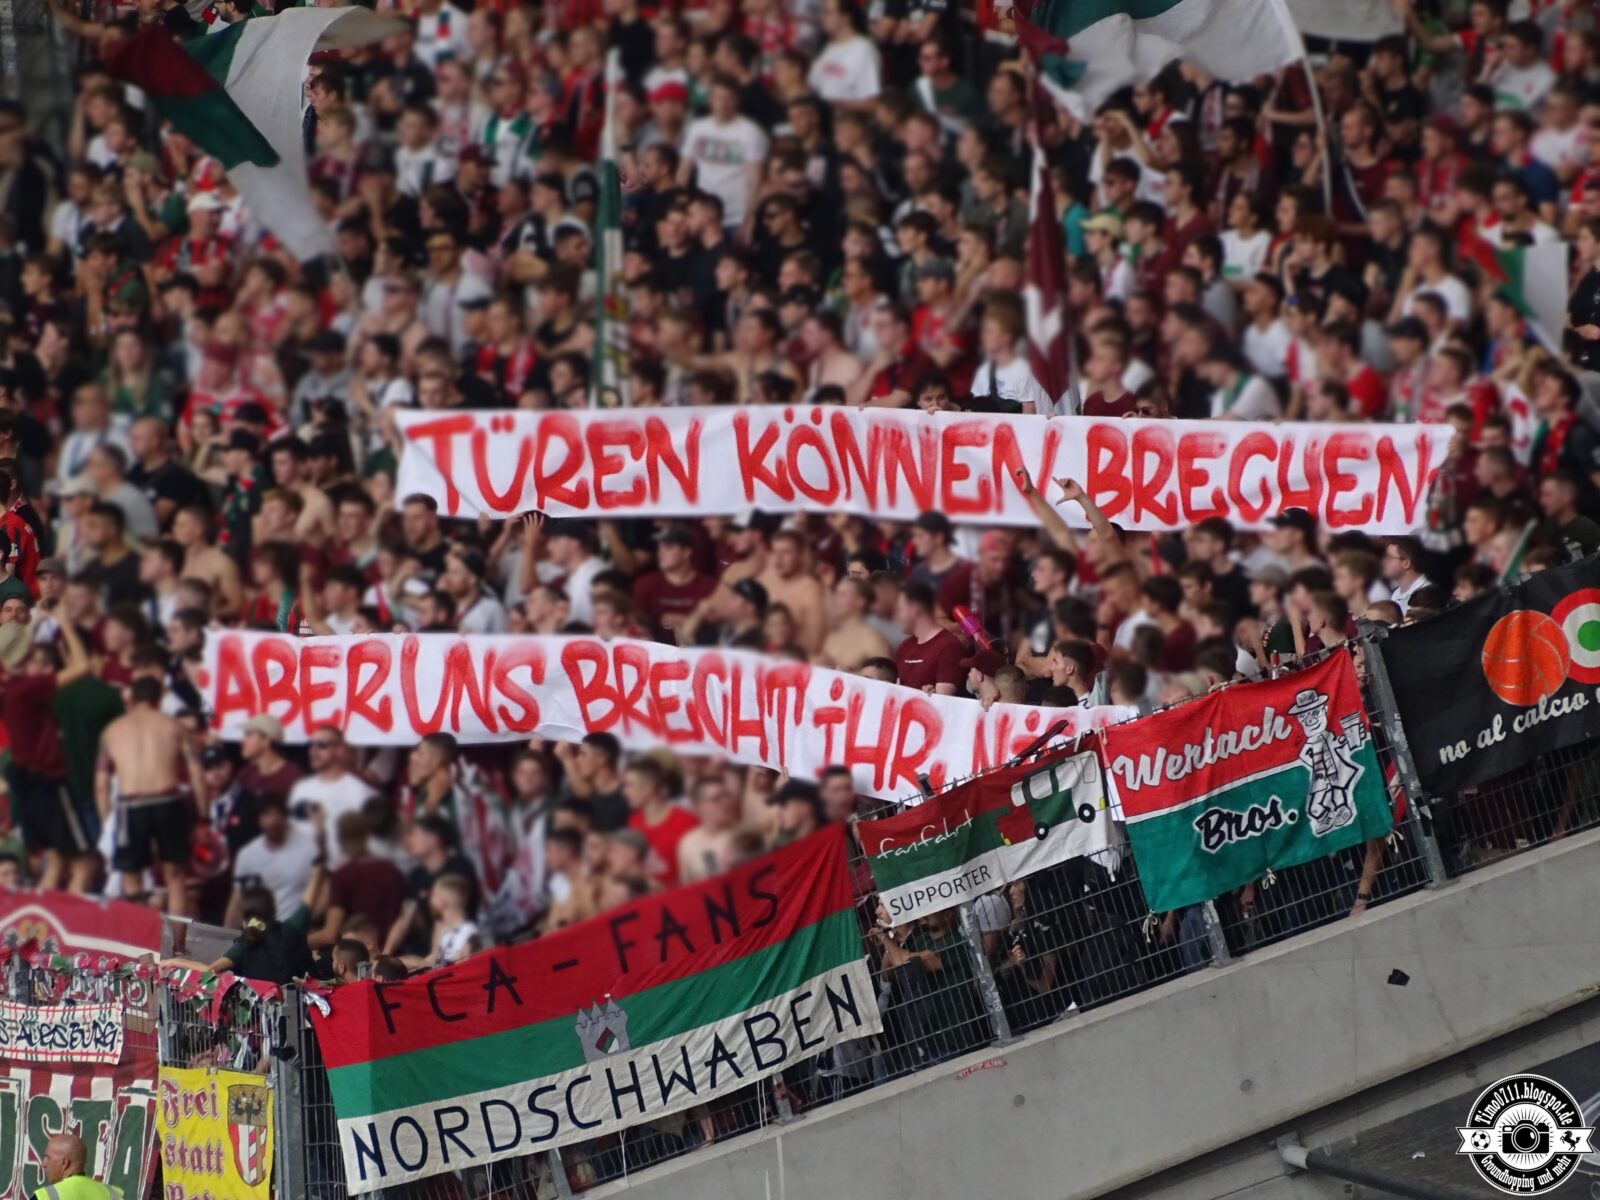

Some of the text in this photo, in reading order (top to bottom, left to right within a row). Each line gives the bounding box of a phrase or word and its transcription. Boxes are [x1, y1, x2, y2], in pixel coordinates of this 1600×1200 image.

[405, 412, 699, 515] TÜREN
[733, 406, 1063, 517] KÖNNEN
[214, 635, 394, 736] ABER
[401, 636, 546, 735] UNS
[560, 641, 810, 768] BRECHT
[1113, 706, 1293, 793] Wertach
[1439, 739, 1471, 764] no
[1477, 713, 1506, 749] al
[1513, 692, 1589, 733] calcio
[1196, 797, 1298, 850] Bros.
[889, 865, 992, 916] SUPPORTER
[374, 962, 523, 1035] FCA
[608, 866, 779, 974] FANS
[351, 975, 861, 1181] NORDSCHWABEN
